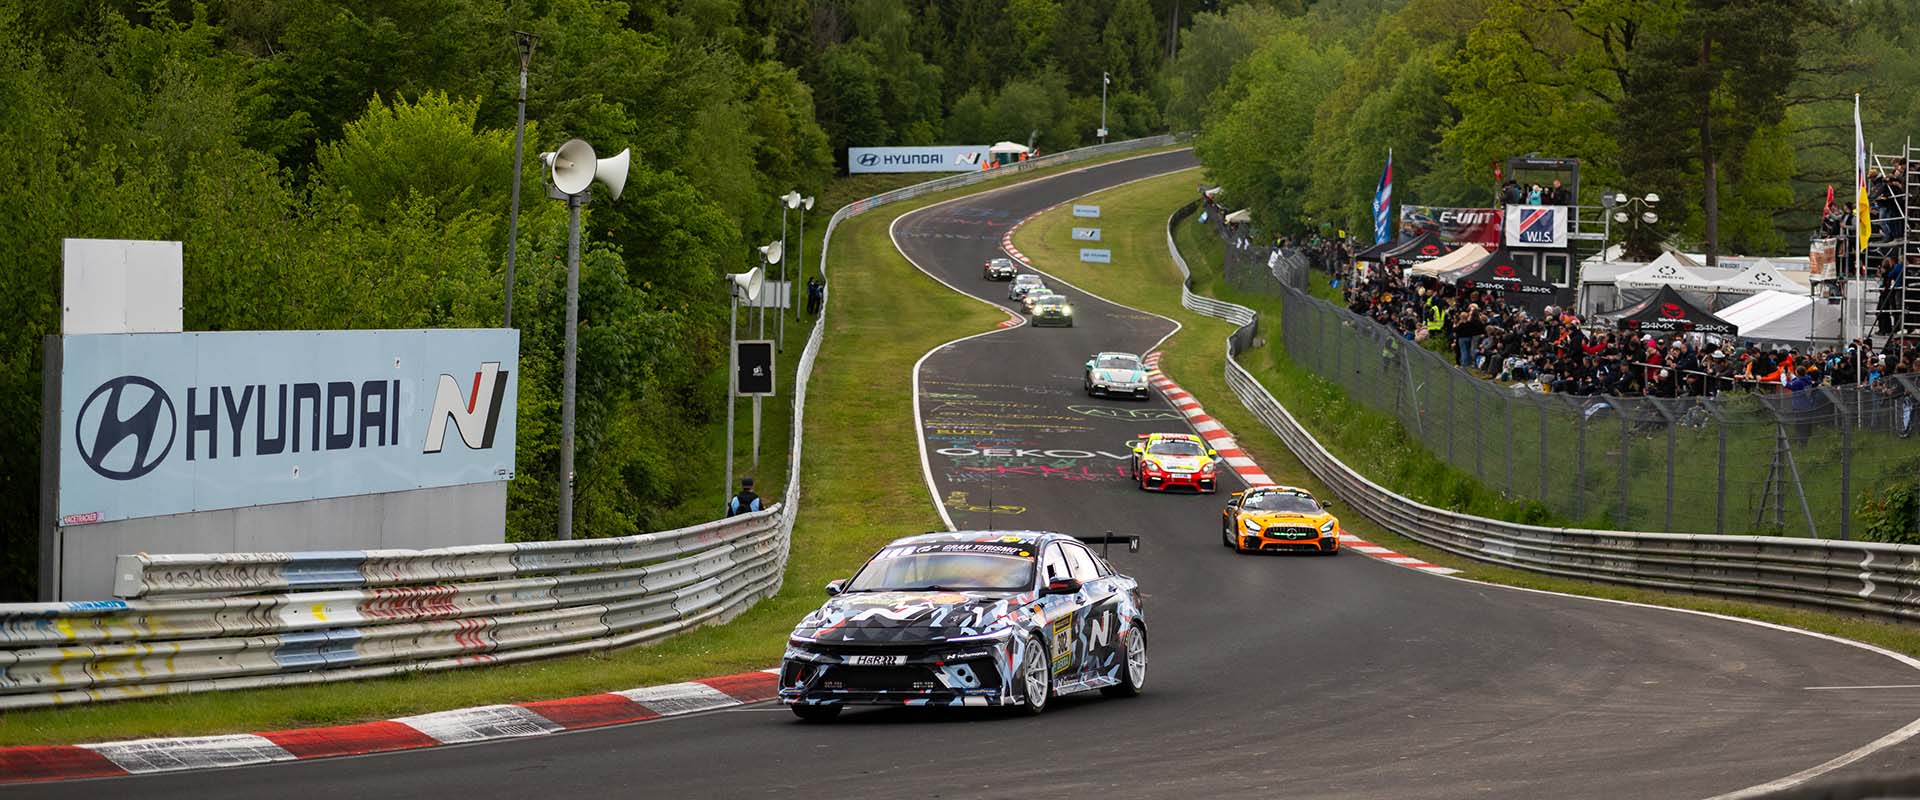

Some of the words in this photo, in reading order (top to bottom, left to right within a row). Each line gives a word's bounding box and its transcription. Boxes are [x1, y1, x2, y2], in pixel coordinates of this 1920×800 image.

[884, 154, 943, 164] HYUNDAI
[1440, 211, 1494, 225] E-UNIT
[1526, 231, 1552, 242] W.I.S.
[1641, 321, 1675, 330] 24MX
[1695, 323, 1729, 332] 24MX
[186, 379, 400, 461] HYUNDAI
[942, 544, 972, 552] GRAN
[973, 545, 1018, 554] TURISMO
[1089, 610, 1113, 652] N
